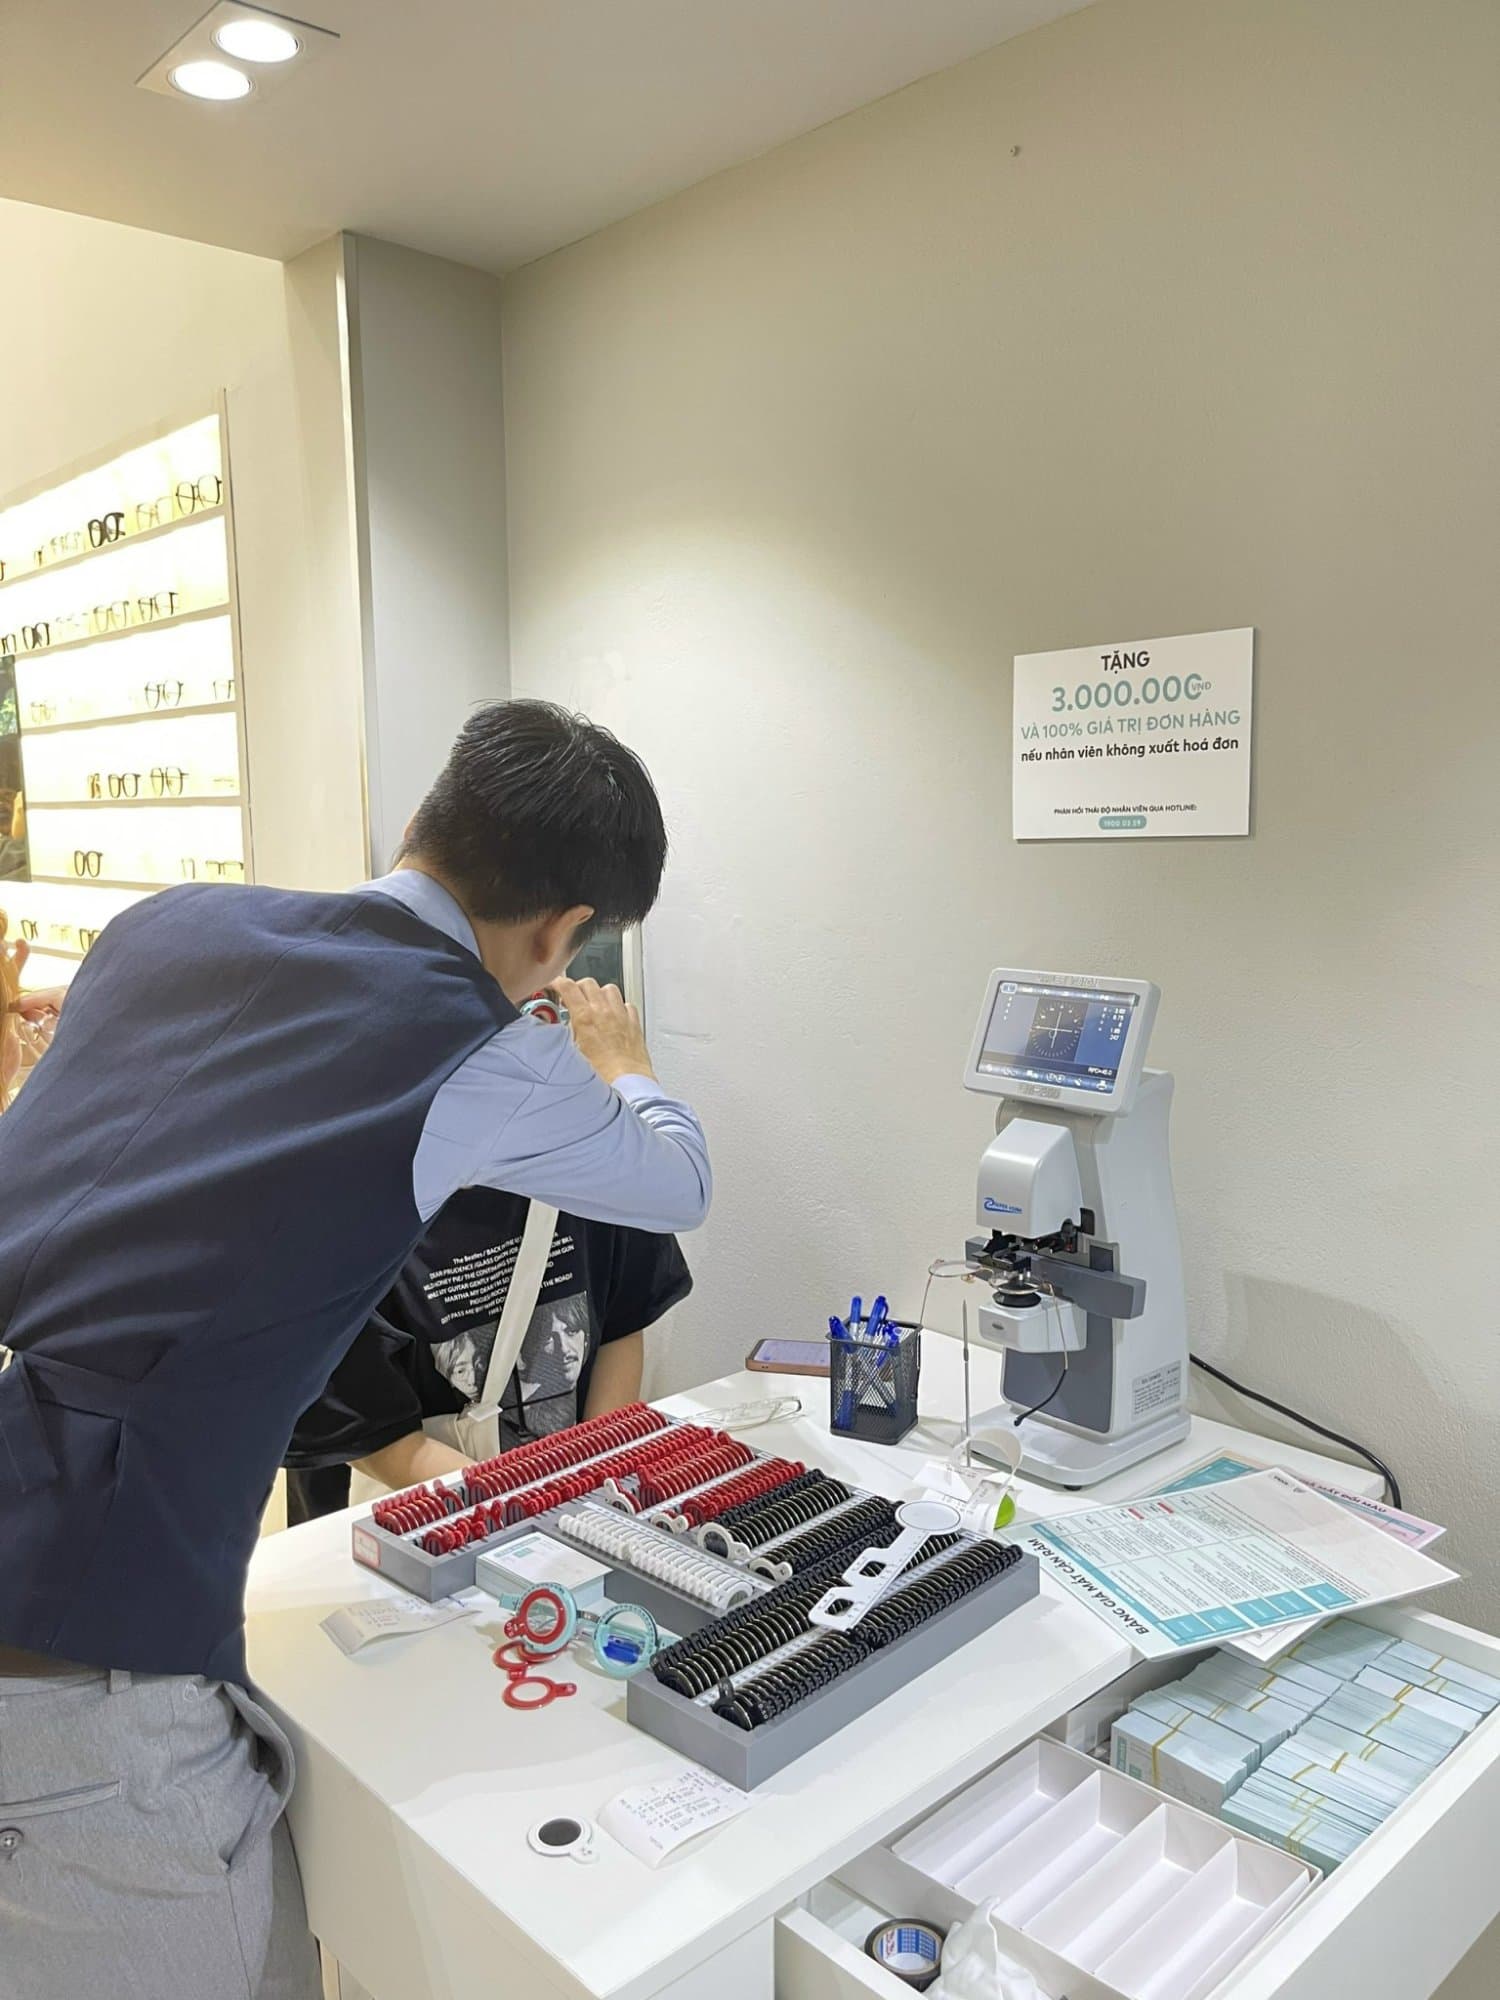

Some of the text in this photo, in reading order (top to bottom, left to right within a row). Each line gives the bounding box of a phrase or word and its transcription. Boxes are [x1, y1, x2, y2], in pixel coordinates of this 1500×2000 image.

[1100, 650, 1151, 674] TẶNG
[1021, 707, 1241, 739] VÀ 100% GIÁ TRỊ ĐƠN HÀNG
[1021, 736, 1239, 762] nếu nhân viên không xuất hoá đơn
[1148, 804, 1164, 813] QUA
[1027, 1537, 1150, 1635] BẢNG GIÁ MẮT CẬN RÂM
